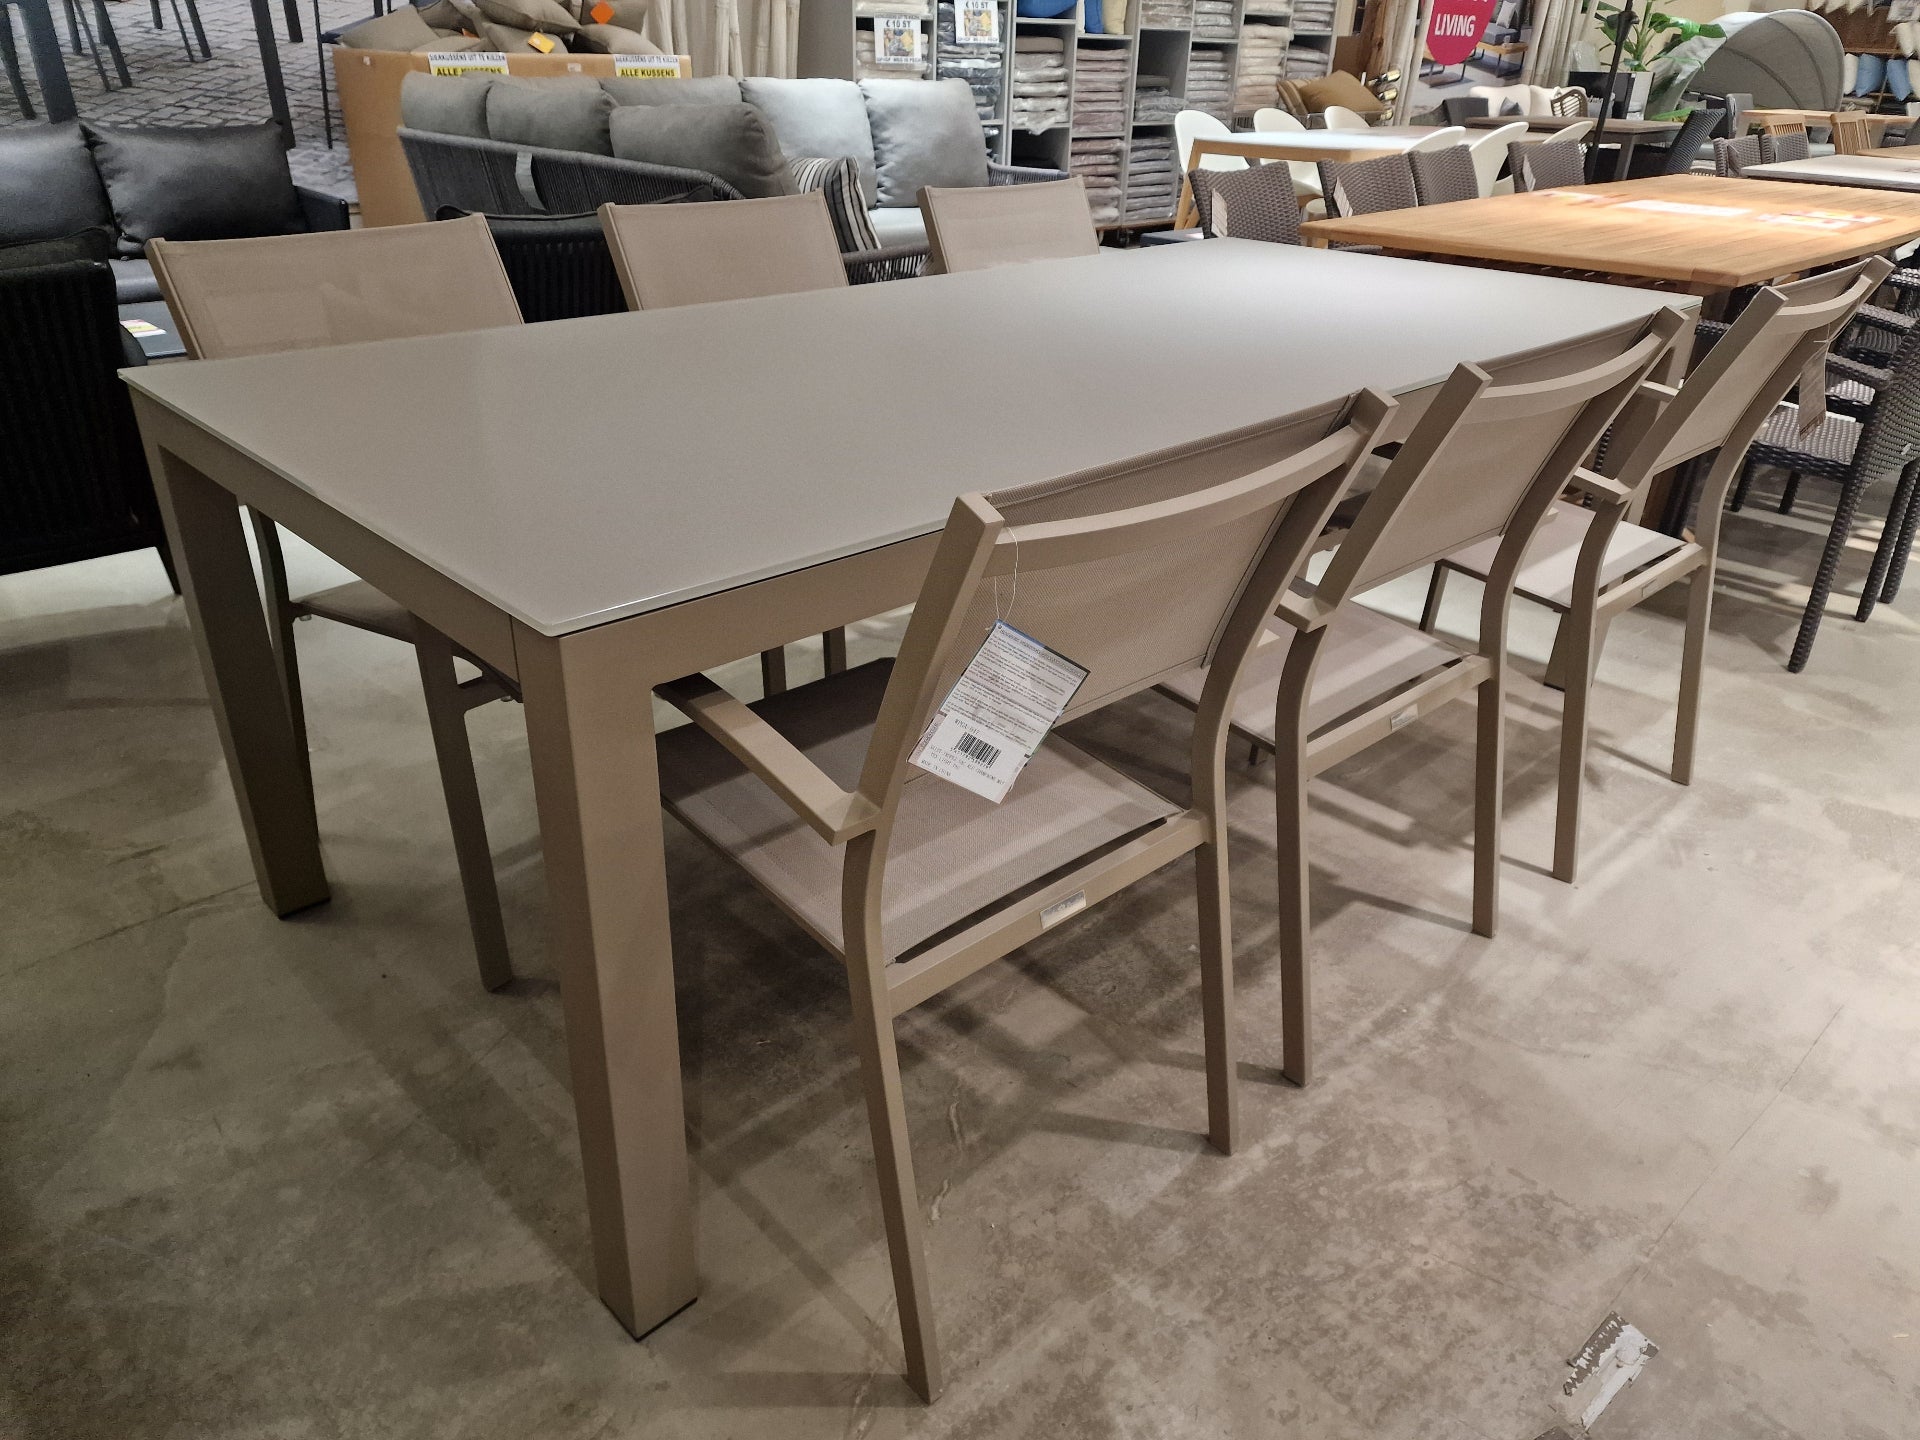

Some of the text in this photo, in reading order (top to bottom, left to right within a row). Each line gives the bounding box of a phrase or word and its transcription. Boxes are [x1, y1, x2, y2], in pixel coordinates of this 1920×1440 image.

[1434, 13, 1476, 37] LIVING
[437, 67, 458, 76] ALLE
[620, 68, 675, 77] ALLE KUSSENS
